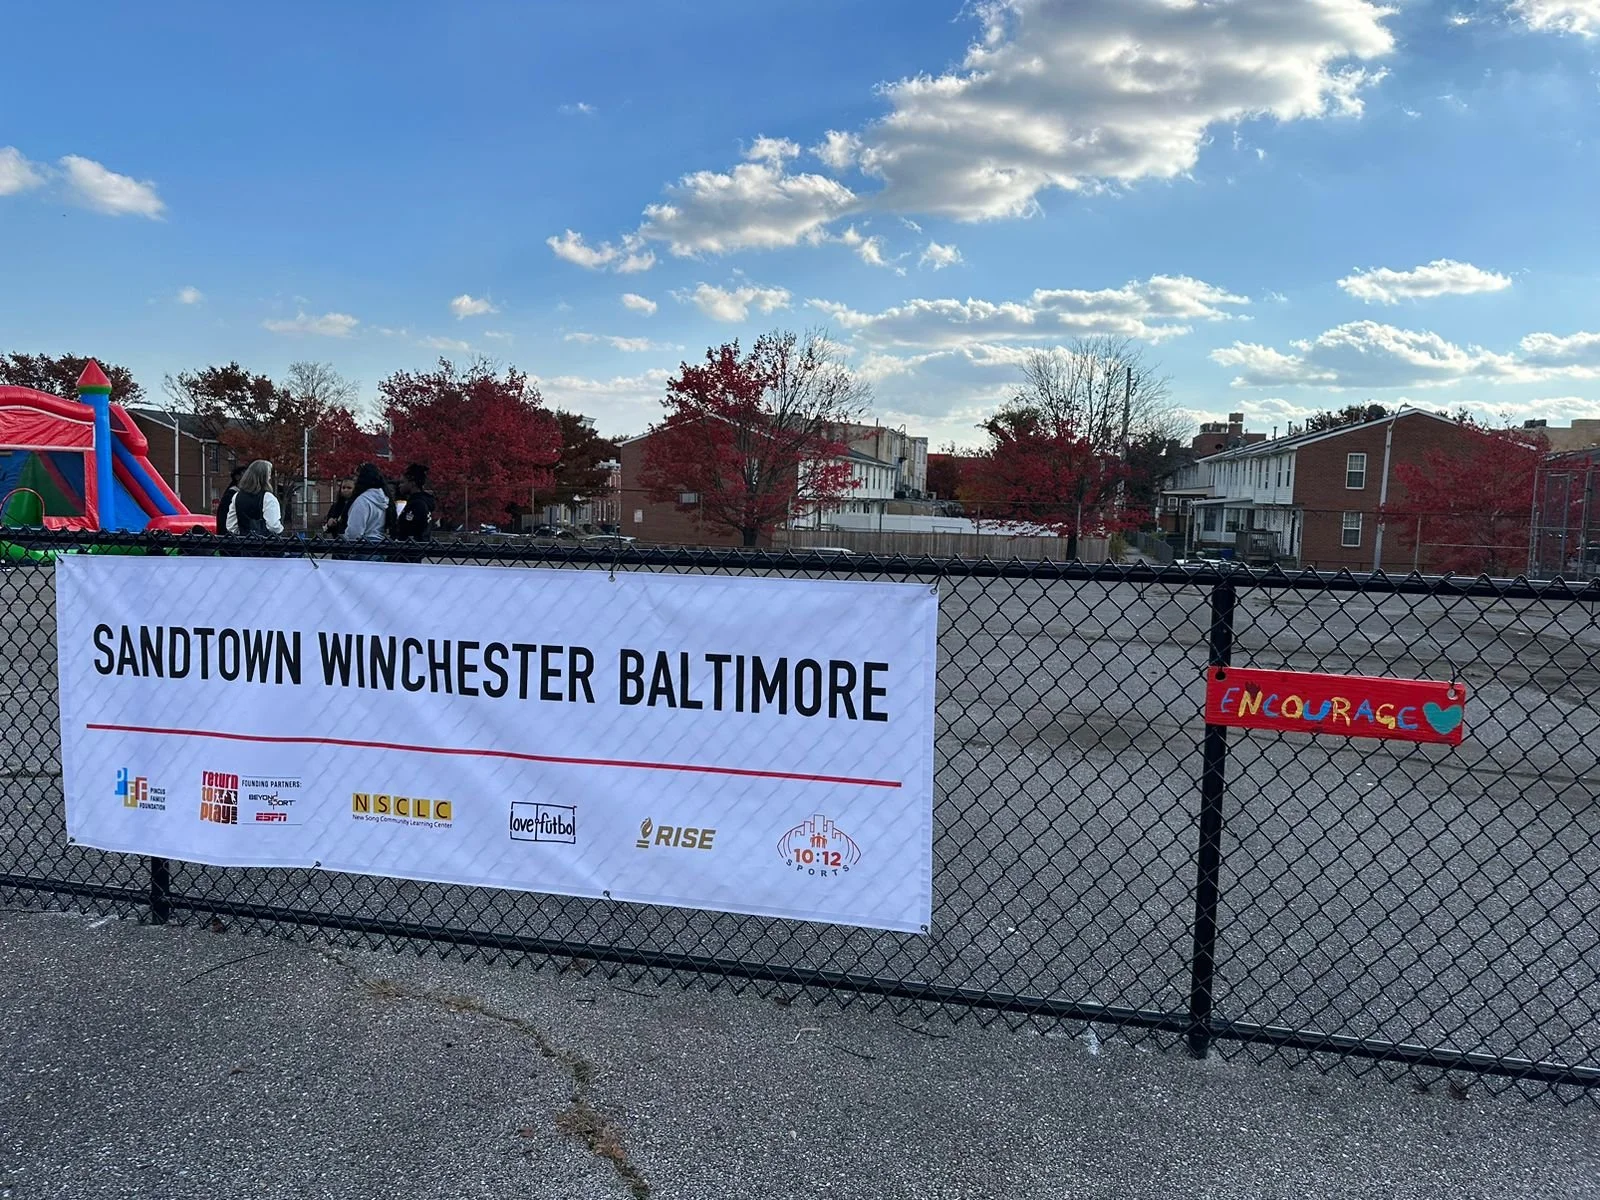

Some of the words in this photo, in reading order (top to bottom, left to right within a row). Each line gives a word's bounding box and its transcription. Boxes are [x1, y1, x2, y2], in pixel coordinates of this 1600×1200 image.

[93, 623, 302, 685] SANDTOWN
[318, 631, 595, 704] WINCHESTER
[620, 648, 889, 722] BALTIMORE
[1220, 687, 1420, 730] ENCOURAGE
[202, 770, 239, 790] return
[241, 779, 269, 788] FOUNDING
[270, 780, 303, 789] PARTNERS:
[202, 786, 214, 802] to
[139, 802, 166, 811] FOUNDATION
[200, 802, 231, 824] play
[255, 812, 287, 822] ESPN
[365, 815, 380, 823] Song
[380, 816, 409, 826] Community
[410, 819, 434, 829] Learning
[434, 821, 453, 829] Center
[655, 825, 717, 850] RISE
[793, 848, 842, 867] 10:12
[785, 858, 850, 878] SPORTS
